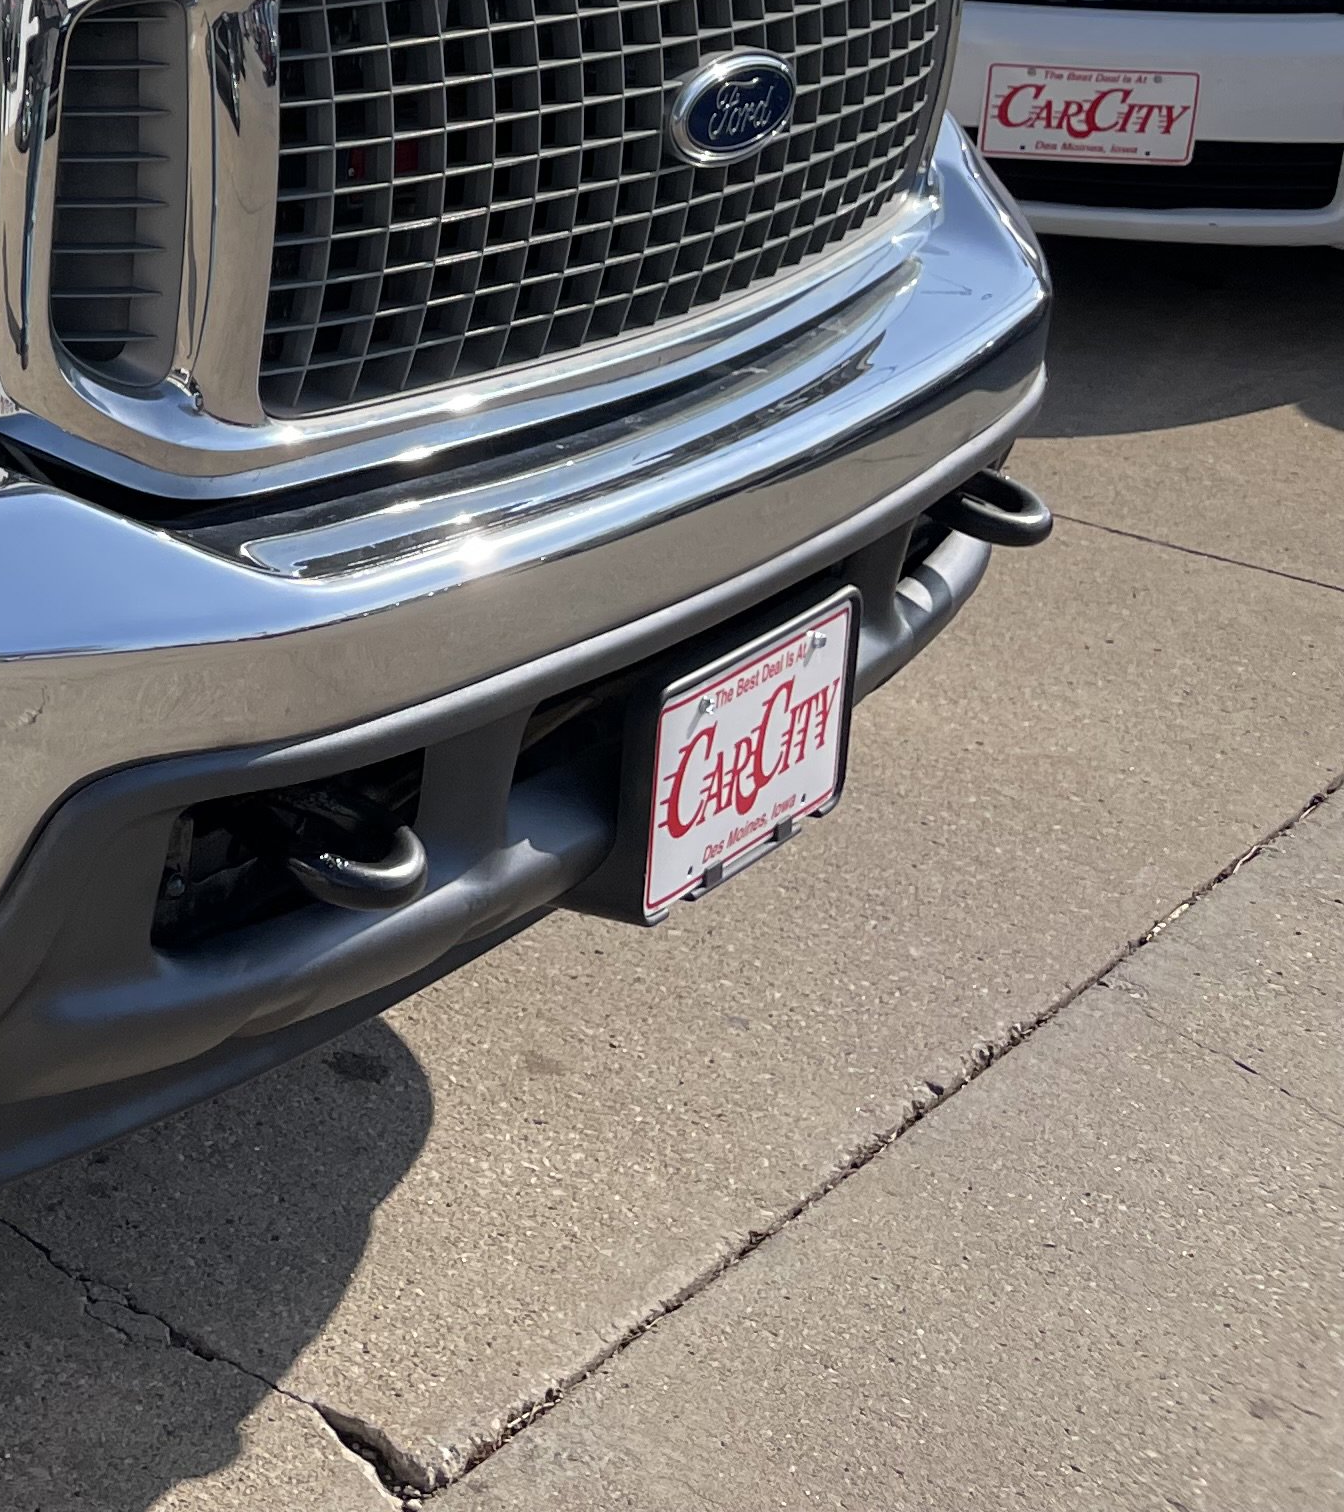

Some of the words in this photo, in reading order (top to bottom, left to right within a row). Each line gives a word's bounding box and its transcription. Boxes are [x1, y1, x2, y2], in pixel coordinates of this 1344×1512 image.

[1044, 70, 1064, 80] The
[1067, 72, 1092, 82] Best
[1095, 73, 1119, 84] Deal
[1135, 75, 1147, 85] At
[708, 76, 775, 141] Ford
[1034, 140, 1057, 150] Des
[1061, 142, 1106, 154] Moines,
[1110, 144, 1138, 154] Iowa
[715, 685, 734, 709] The
[736, 672, 760, 698] Best
[761, 654, 784, 681] Deal
[785, 648, 795, 670] Is
[702, 839, 725, 864] Des
[772, 794, 796, 819] Iowa
